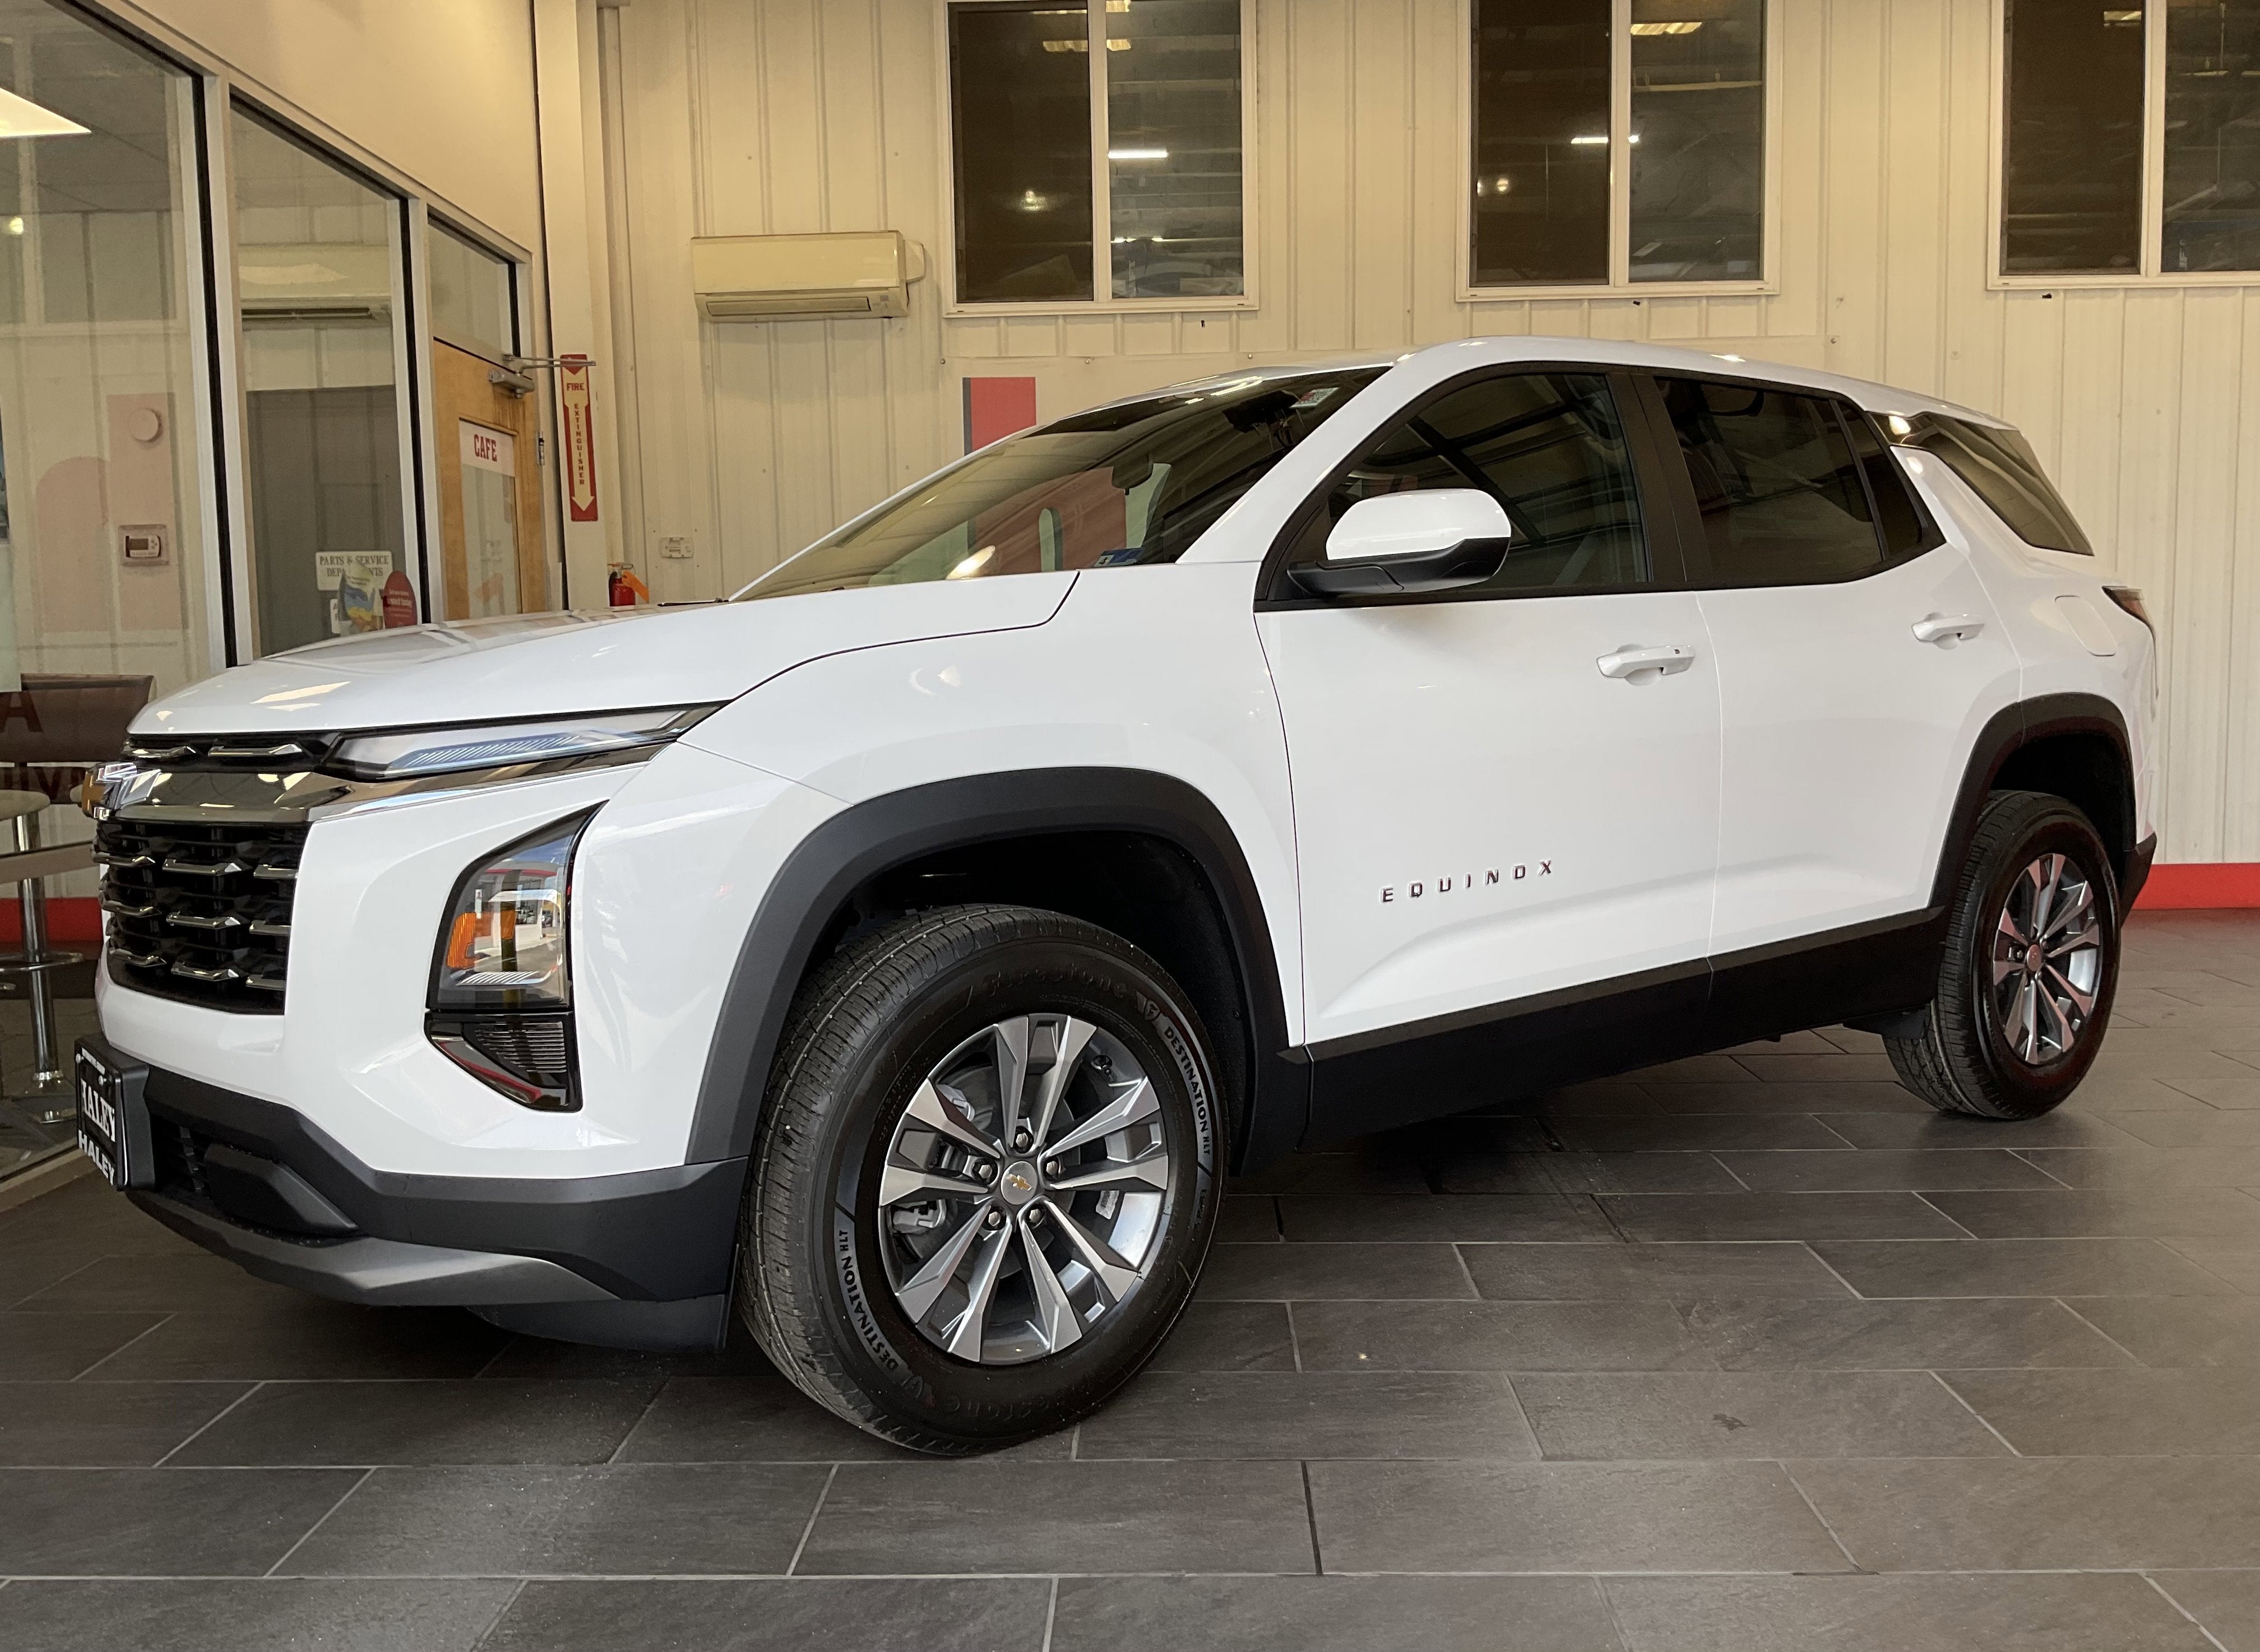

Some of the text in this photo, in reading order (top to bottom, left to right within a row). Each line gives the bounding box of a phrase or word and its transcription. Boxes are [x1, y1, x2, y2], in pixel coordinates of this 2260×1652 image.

[566, 383, 585, 391] FIRE
[474, 434, 497, 462] CAFE
[573, 403, 585, 485] EXTINGUISHER
[319, 556, 344, 565] PARTS
[355, 555, 389, 565] SERVICE
[1380, 860, 1552, 903] EQUINOX
[1164, 1026, 1208, 1133] DESTINATION
[78, 1129, 115, 1186] HALEY
[839, 1230, 899, 1372] DESTINATION HLT
